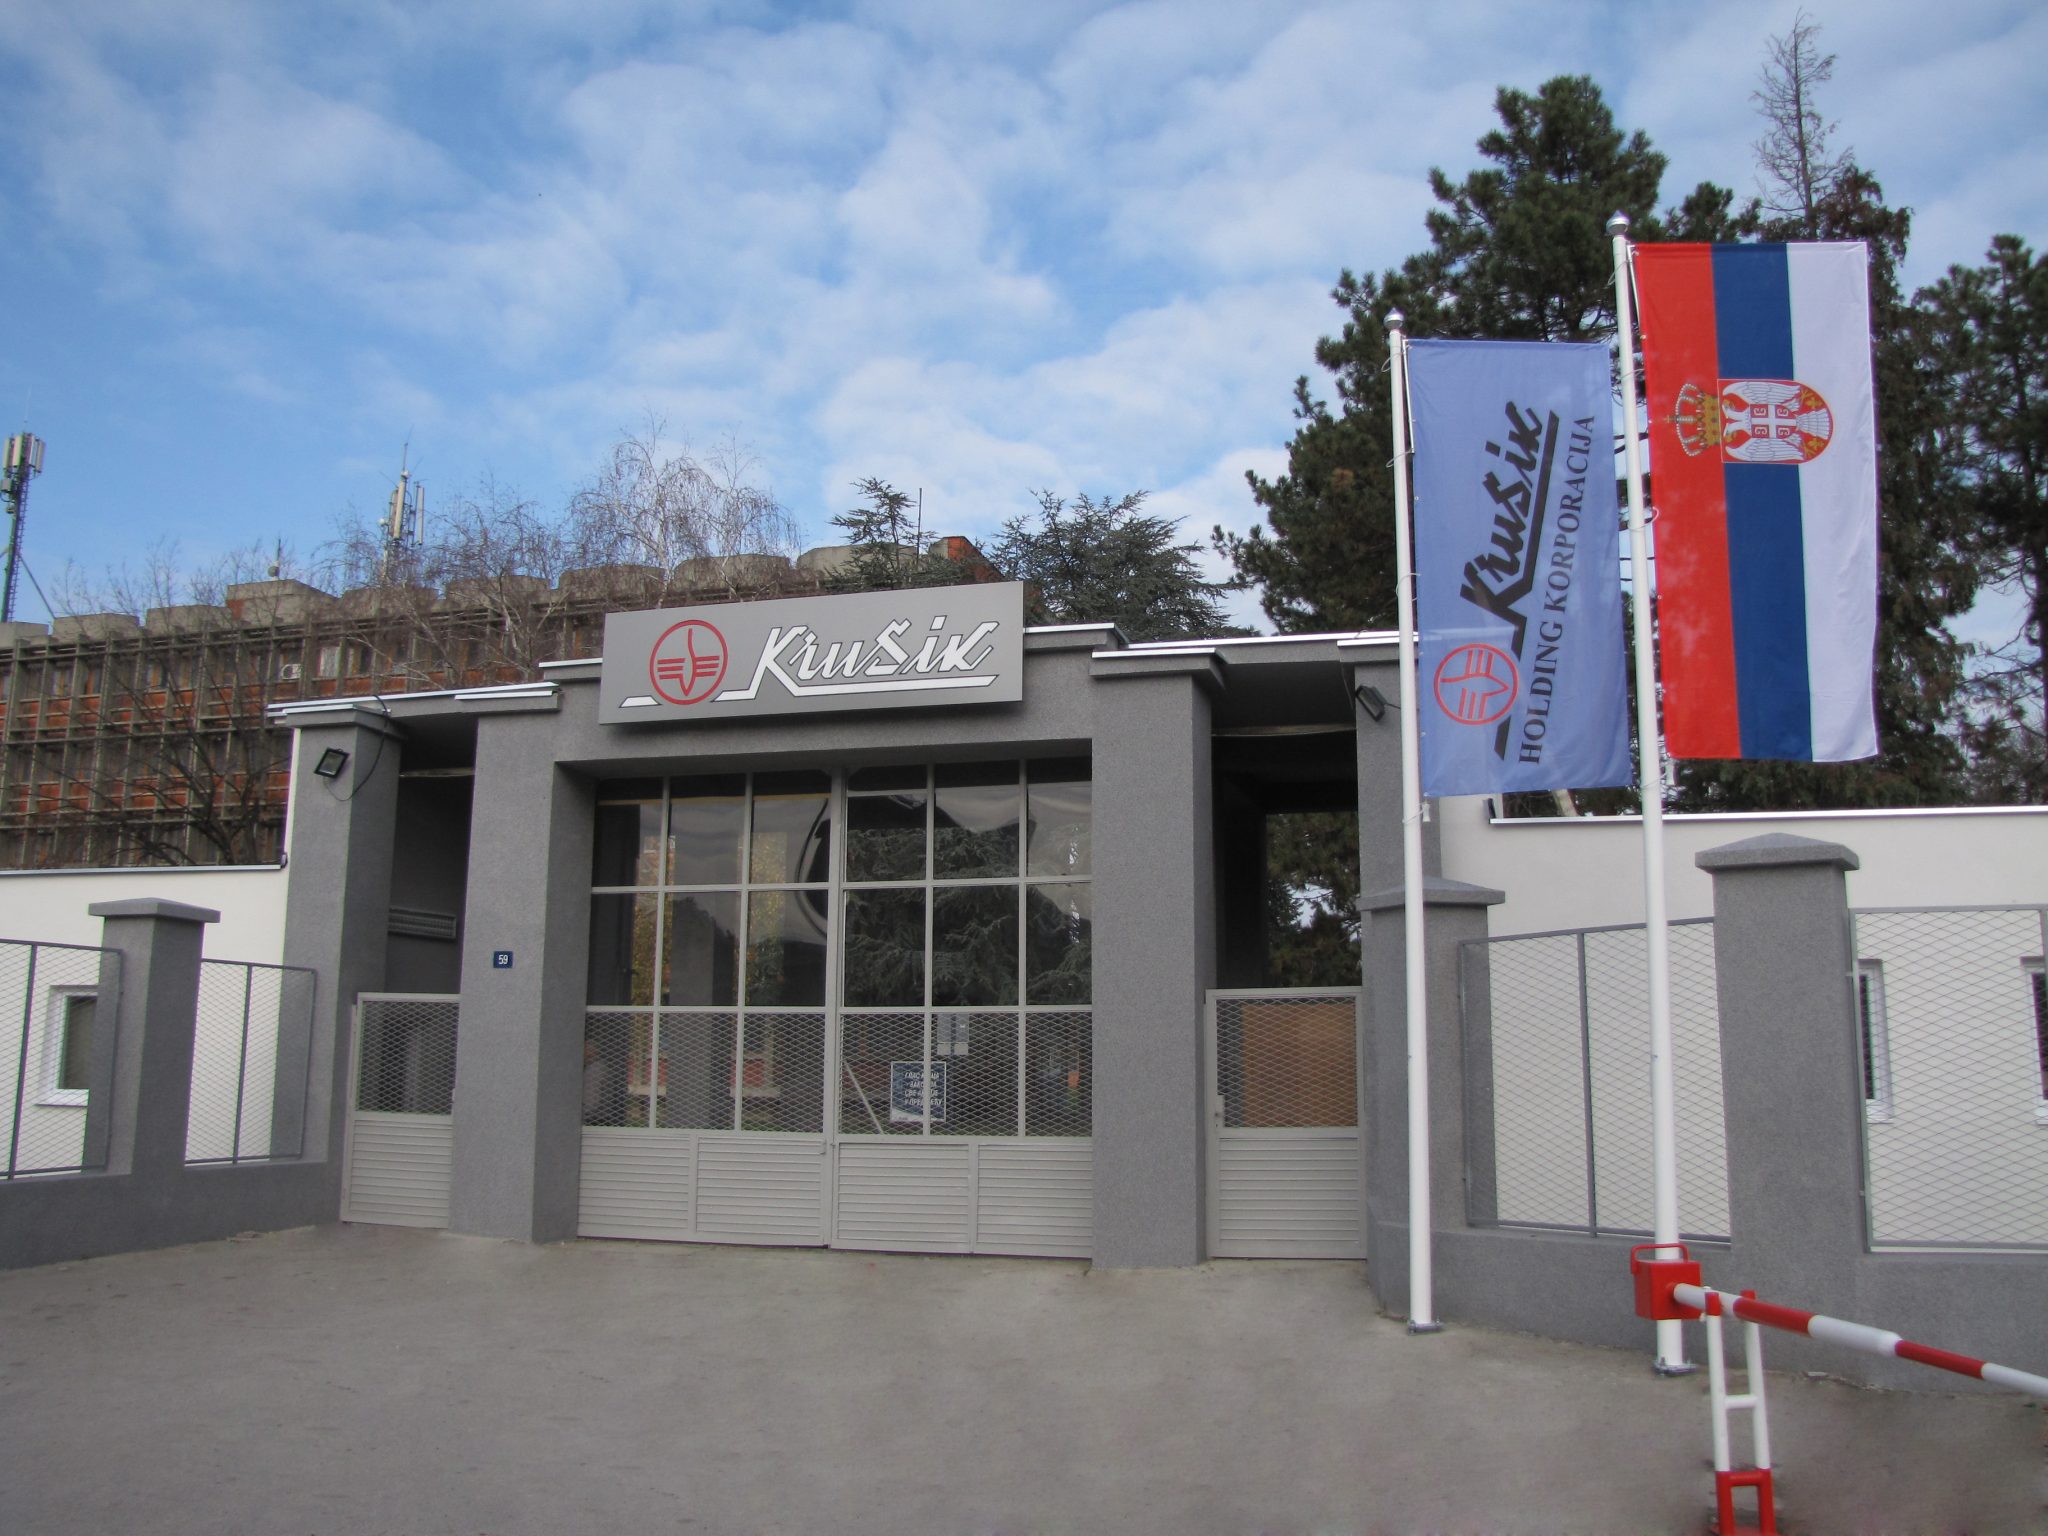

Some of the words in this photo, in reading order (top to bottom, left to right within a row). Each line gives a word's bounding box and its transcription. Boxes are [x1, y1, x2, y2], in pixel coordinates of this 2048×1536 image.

[1519, 621, 1563, 764] HOLDING
[1544, 415, 1595, 614] KORPORACIJA
[498, 954, 509, 965] 59
